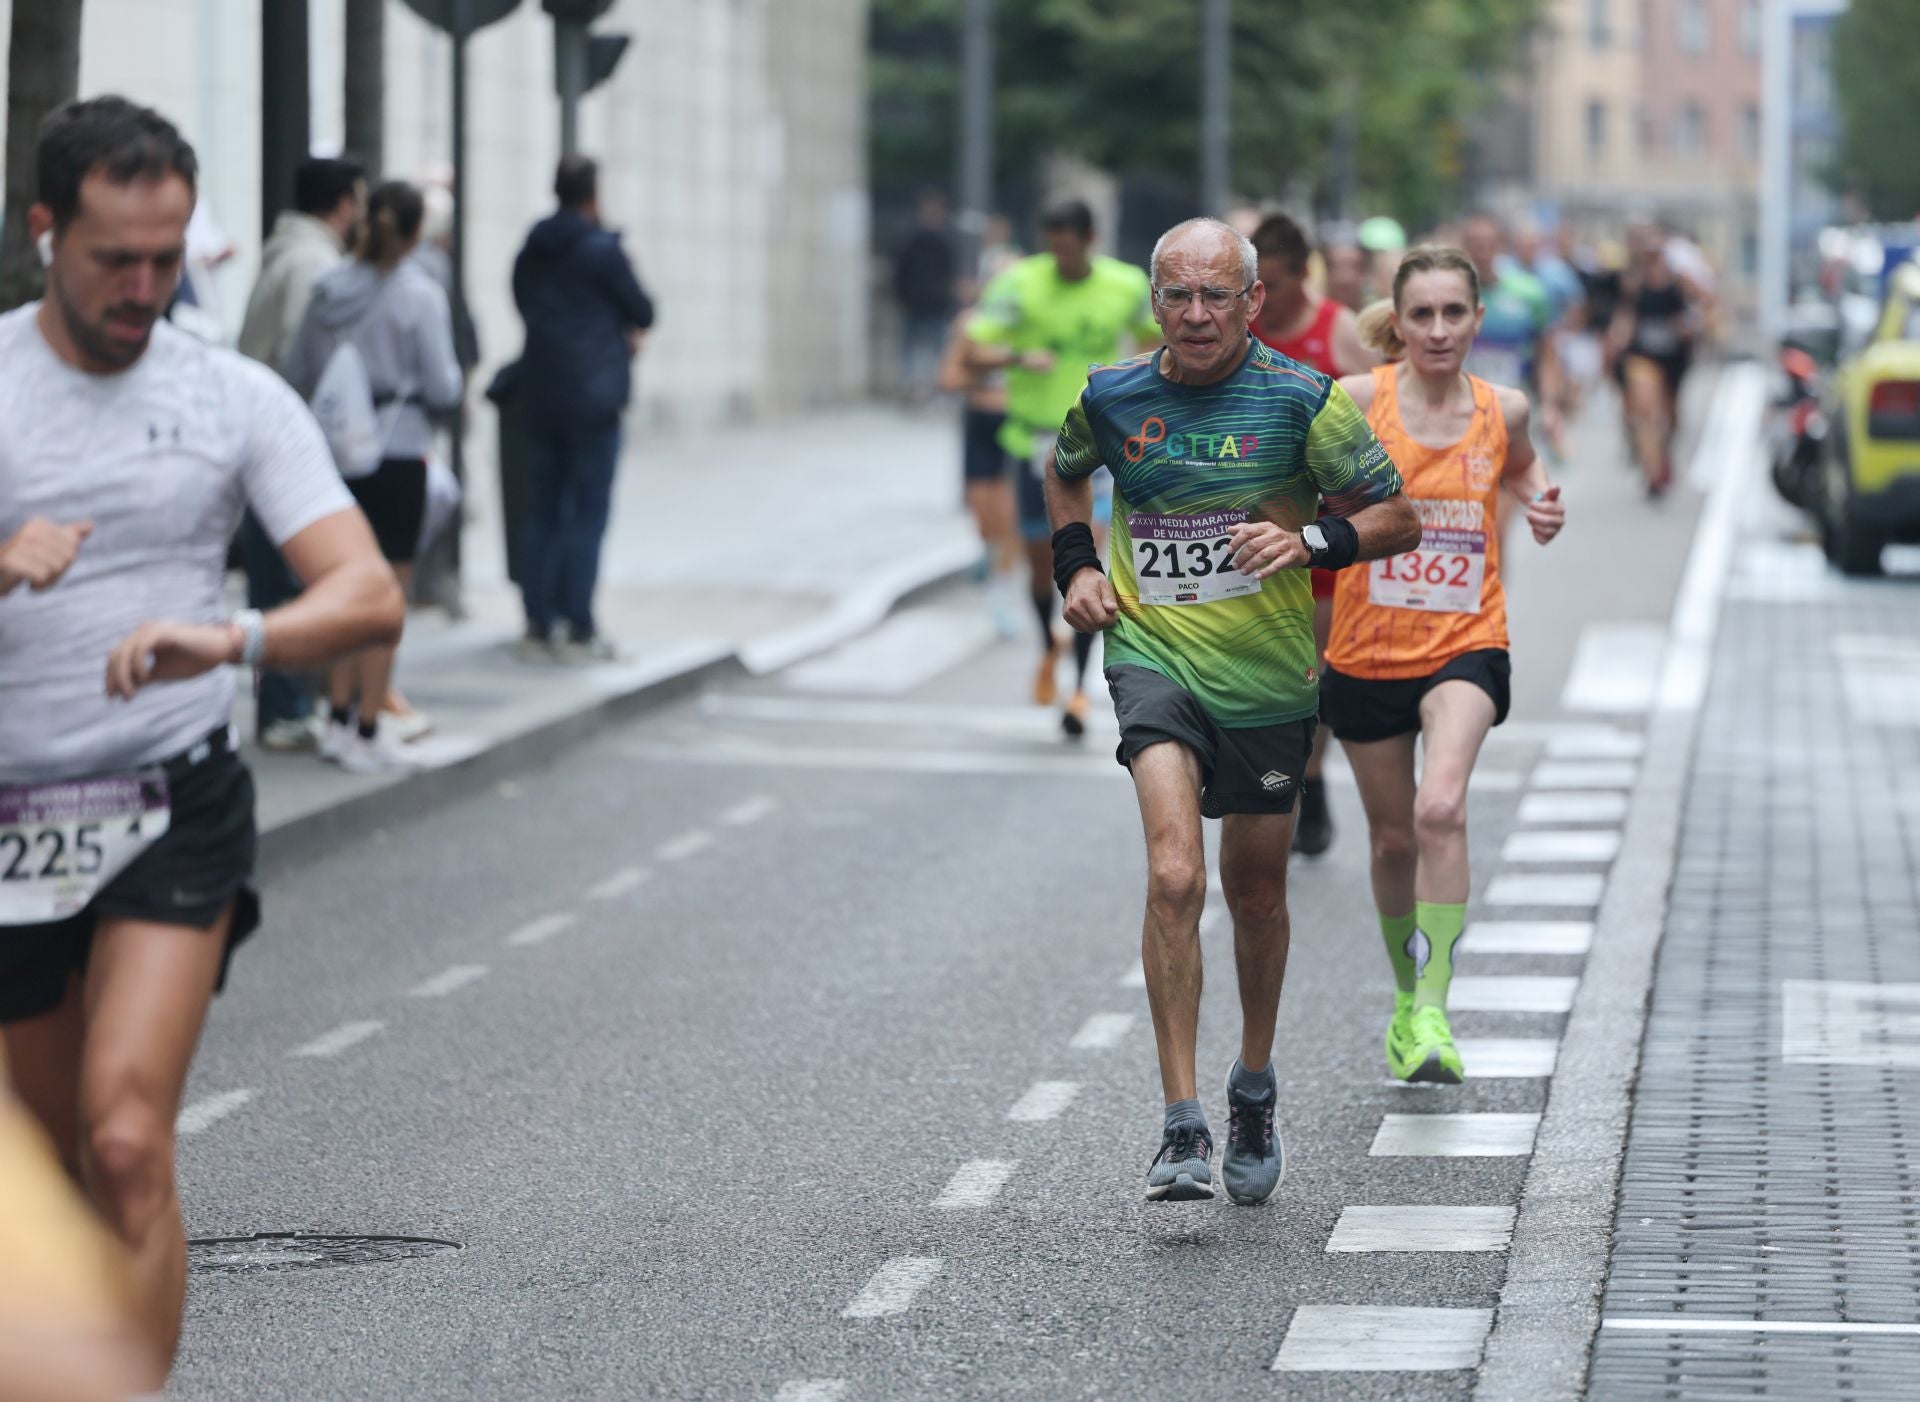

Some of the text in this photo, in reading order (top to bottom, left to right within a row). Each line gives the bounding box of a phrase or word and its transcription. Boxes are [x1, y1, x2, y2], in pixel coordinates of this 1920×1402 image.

[1166, 432, 1259, 459] GTTAP
[1159, 518, 1190, 528] MEDIA
[1192, 511, 1246, 528] MARATÓN
[1153, 528, 1166, 538] DE
[1138, 537, 1236, 578] 2132
[1379, 552, 1470, 587] 1362
[1178, 582, 1200, 590] PACO
